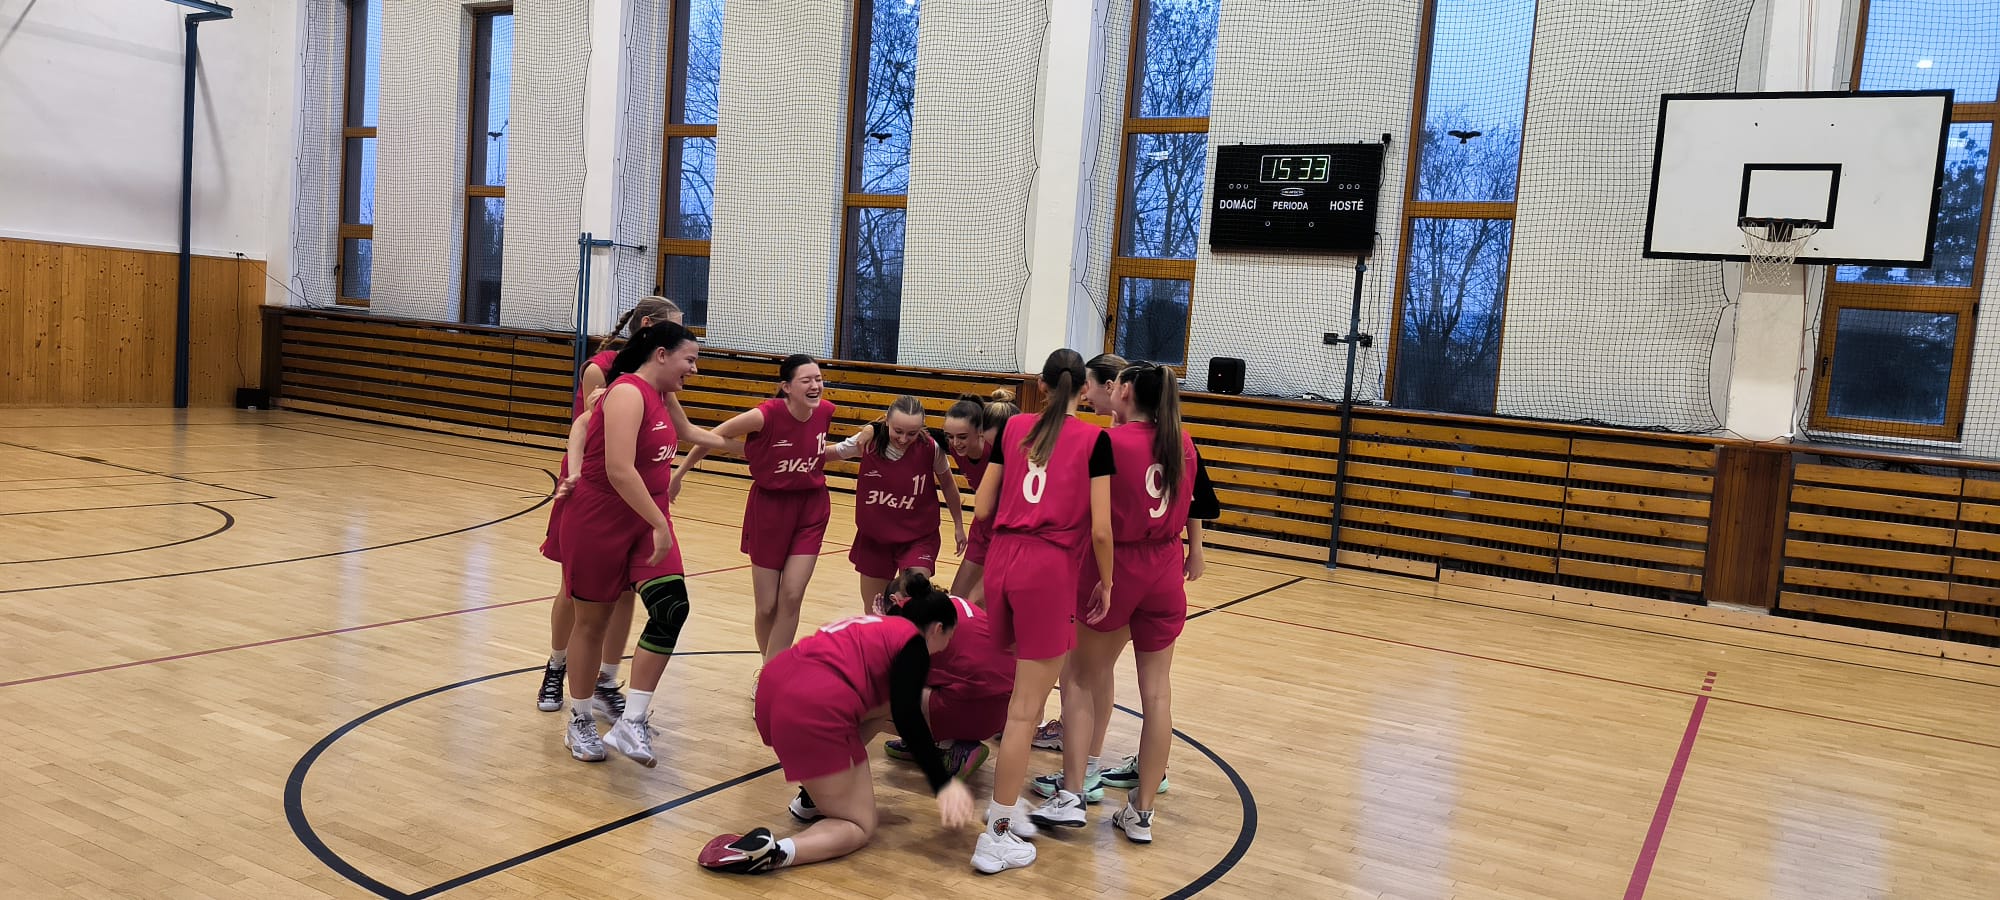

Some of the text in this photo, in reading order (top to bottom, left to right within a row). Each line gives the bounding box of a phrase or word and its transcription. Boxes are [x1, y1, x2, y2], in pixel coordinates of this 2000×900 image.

[1219, 197, 1257, 210] DOMÁCÍ
[1272, 201, 1309, 211] PERIODA
[1329, 198, 1364, 211] HOSTÉ
[912, 474, 926, 496] 11
[1022, 458, 1047, 504] 8
[1145, 463, 1170, 519] 9
